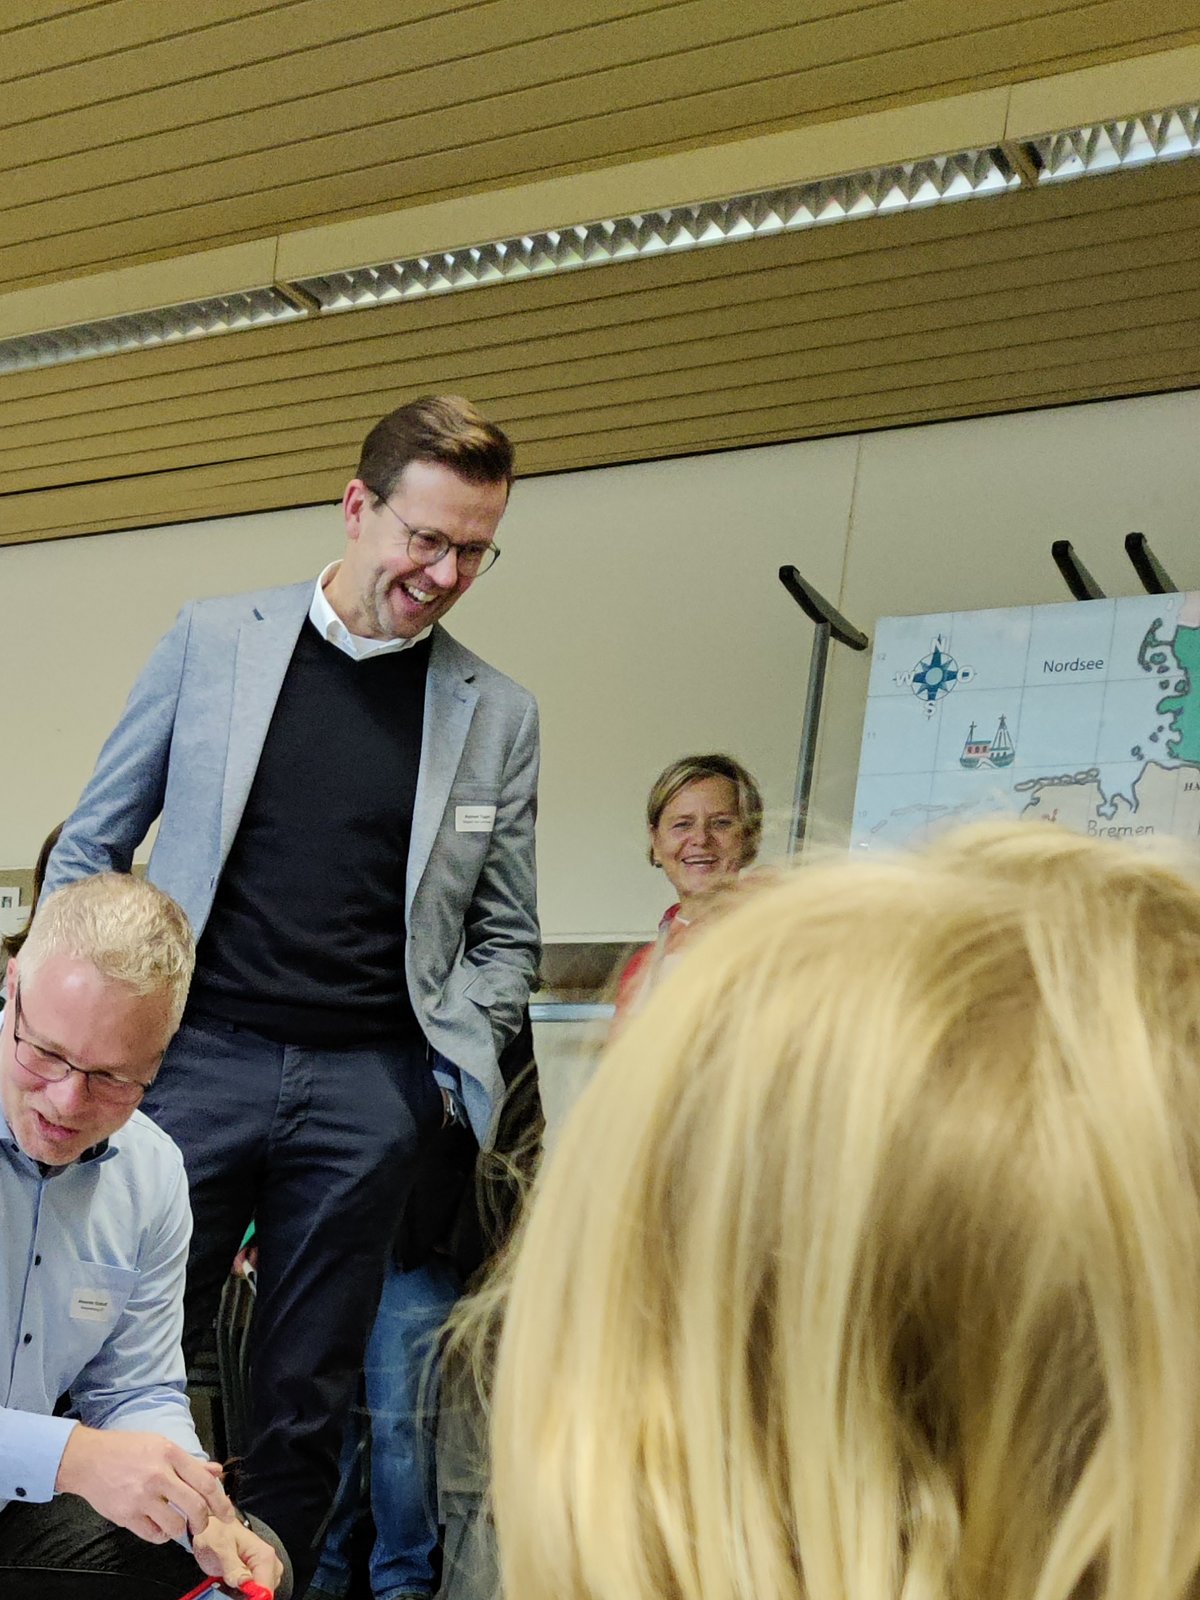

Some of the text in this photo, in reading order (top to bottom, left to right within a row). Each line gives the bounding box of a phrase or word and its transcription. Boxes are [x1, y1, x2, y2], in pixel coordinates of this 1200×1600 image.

[1043, 657, 1104, 673] Nordsee
[895, 672, 915, 687] W
[1087, 819, 1154, 838] Bremen
